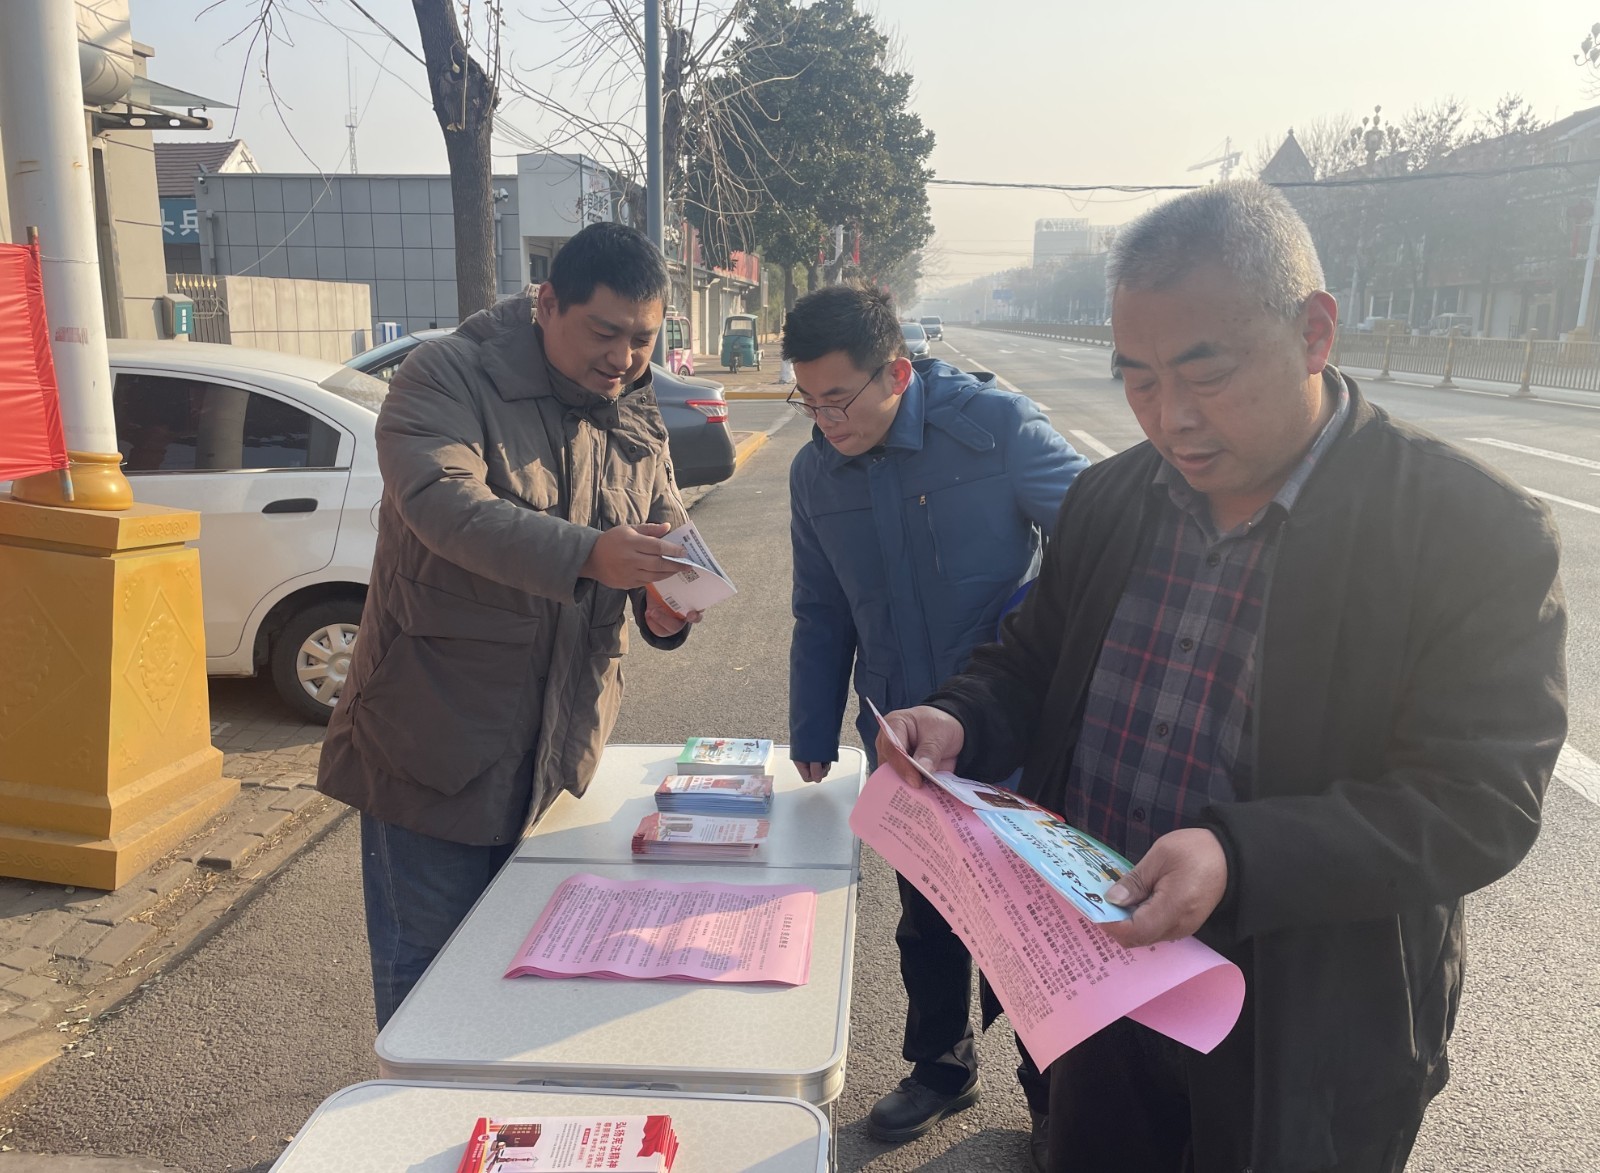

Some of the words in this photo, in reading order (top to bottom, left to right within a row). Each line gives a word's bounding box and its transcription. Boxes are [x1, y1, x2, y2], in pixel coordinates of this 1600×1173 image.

[606, 1122, 627, 1168] 弘扬宪法精神
